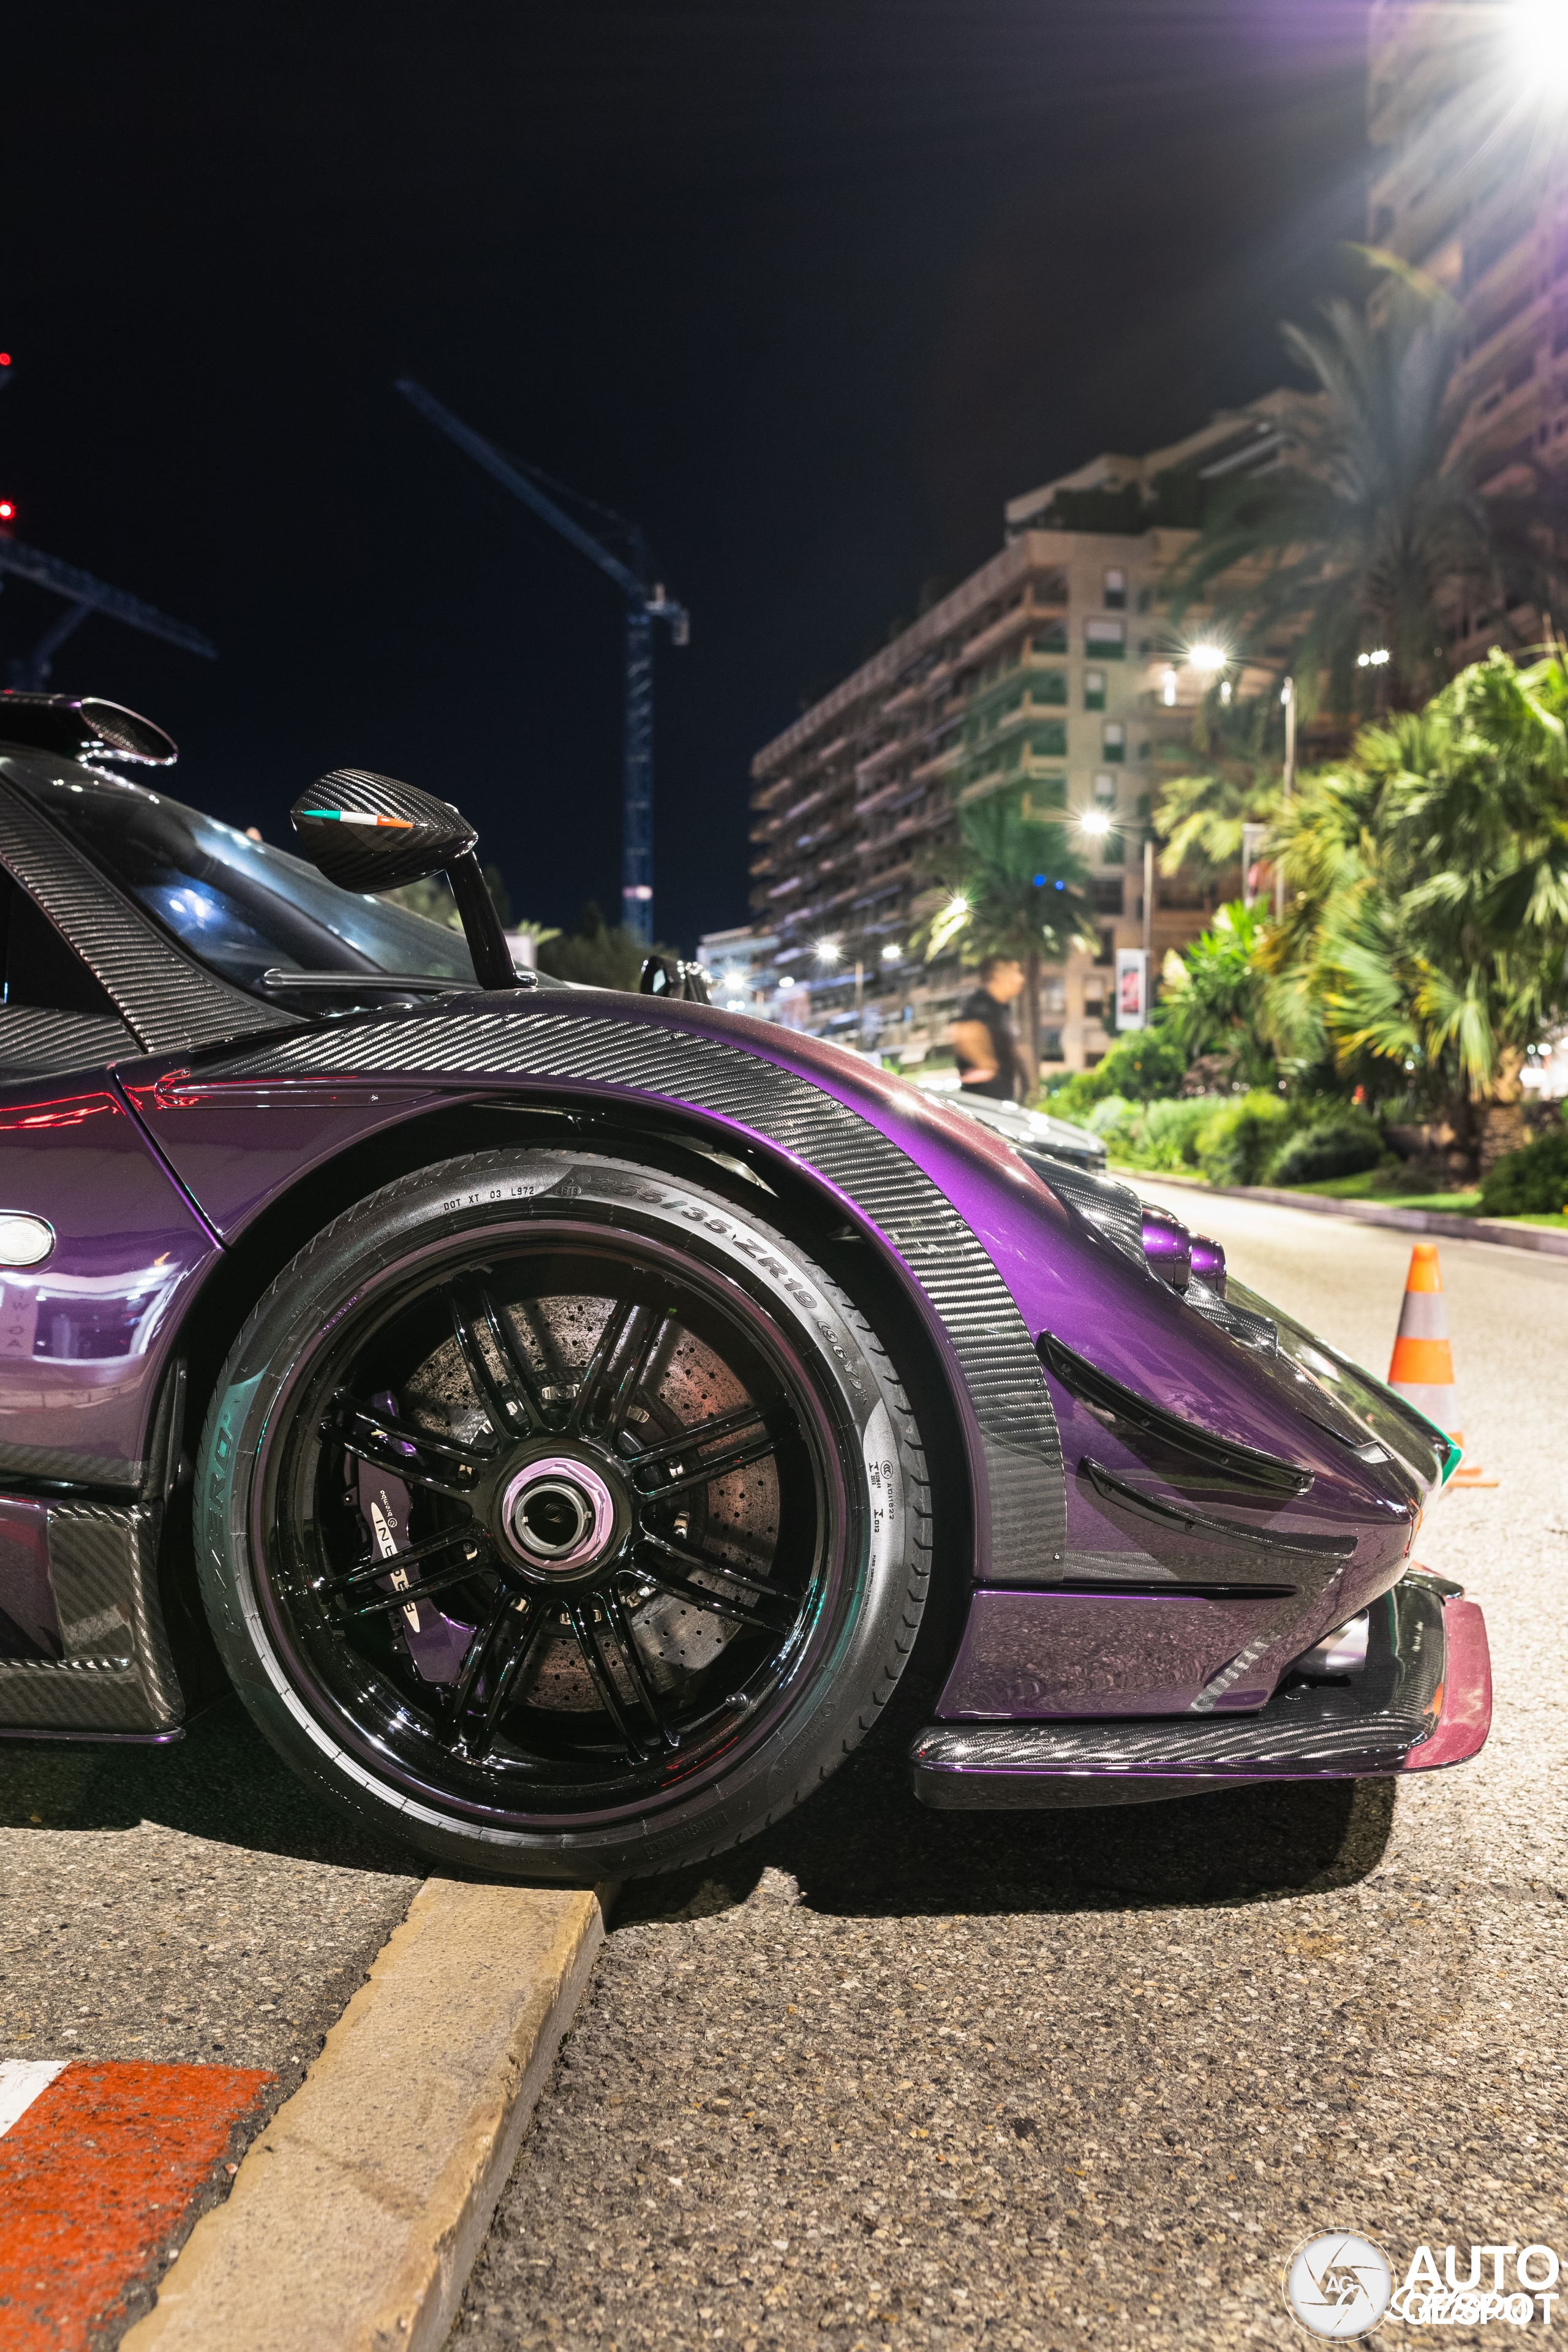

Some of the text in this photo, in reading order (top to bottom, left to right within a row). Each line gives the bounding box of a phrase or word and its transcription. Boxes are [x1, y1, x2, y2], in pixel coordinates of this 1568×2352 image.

[443, 1186, 534, 1212] DOT XT 03 L972
[586, 1178, 733, 1234] 255/35
[733, 1238, 818, 1308] ZR19
[380, 1490, 393, 1518] brembo
